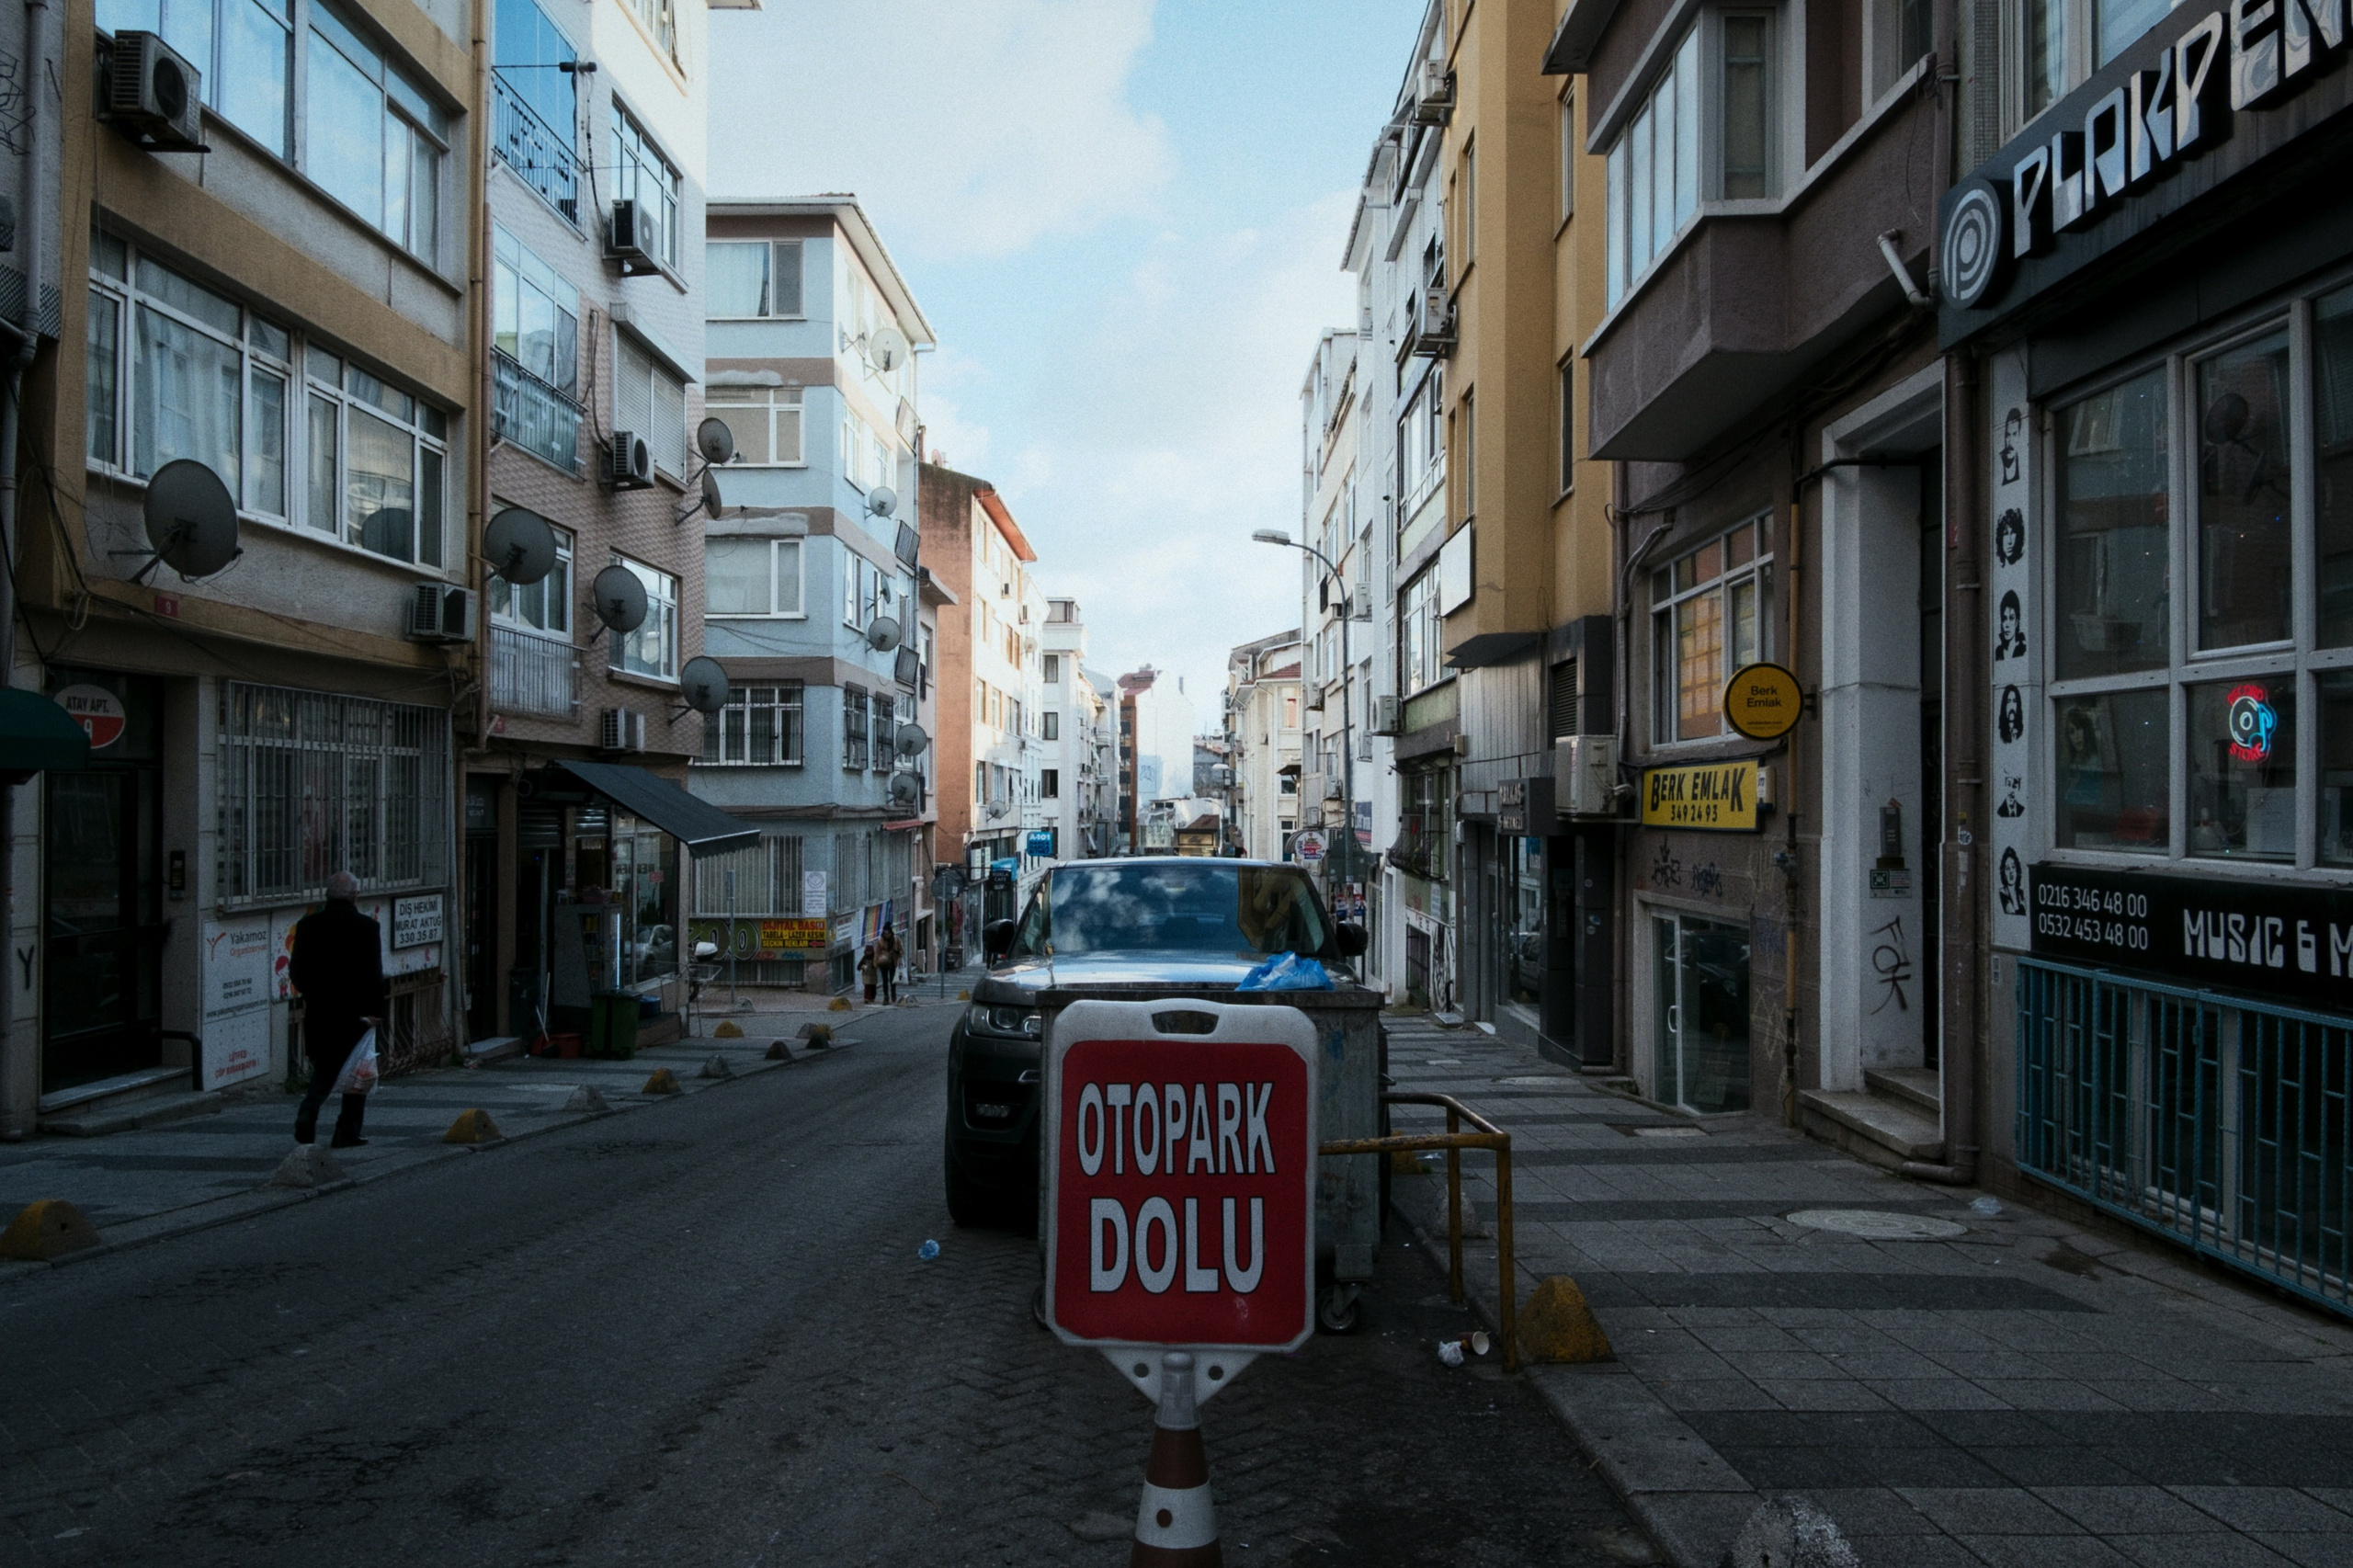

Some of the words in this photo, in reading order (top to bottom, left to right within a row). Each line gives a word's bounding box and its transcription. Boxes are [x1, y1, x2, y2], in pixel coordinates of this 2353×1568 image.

[2014, 0, 2353, 259] PLAKPEN
[1750, 685, 1778, 696] Berk
[2226, 684, 2263, 706] RECORD
[66, 697, 88, 710] ATAY
[90, 699, 109, 713] APT.
[1747, 698, 1781, 708] Emlak
[2229, 741, 2265, 762] STORE
[1651, 773, 1686, 812] BERK
[1692, 767, 1746, 812] EMLAK
[1671, 804, 1688, 822] 349
[1690, 804, 1702, 822] 24
[1706, 804, 1718, 822] 93
[400, 901, 412, 917] DİŞ
[2038, 883, 2070, 908] 0216
[2073, 886, 2100, 912] 346
[2103, 890, 2123, 915] 48
[2127, 892, 2148, 918] 00
[395, 919, 417, 931] MURAT
[2038, 912, 2072, 938] 0532
[2075, 916, 2101, 943] 453
[2104, 920, 2124, 947] 48
[2128, 925, 2149, 950] 00
[230, 930, 267, 945] Yakamoz
[400, 932, 415, 944] 330
[417, 930, 426, 941] 35
[428, 928, 438, 939] 87
[2183, 908, 2285, 969] MUSIC
[1077, 1081, 1277, 1176] OTOPARK
[1090, 1196, 1266, 1294] DOLU
